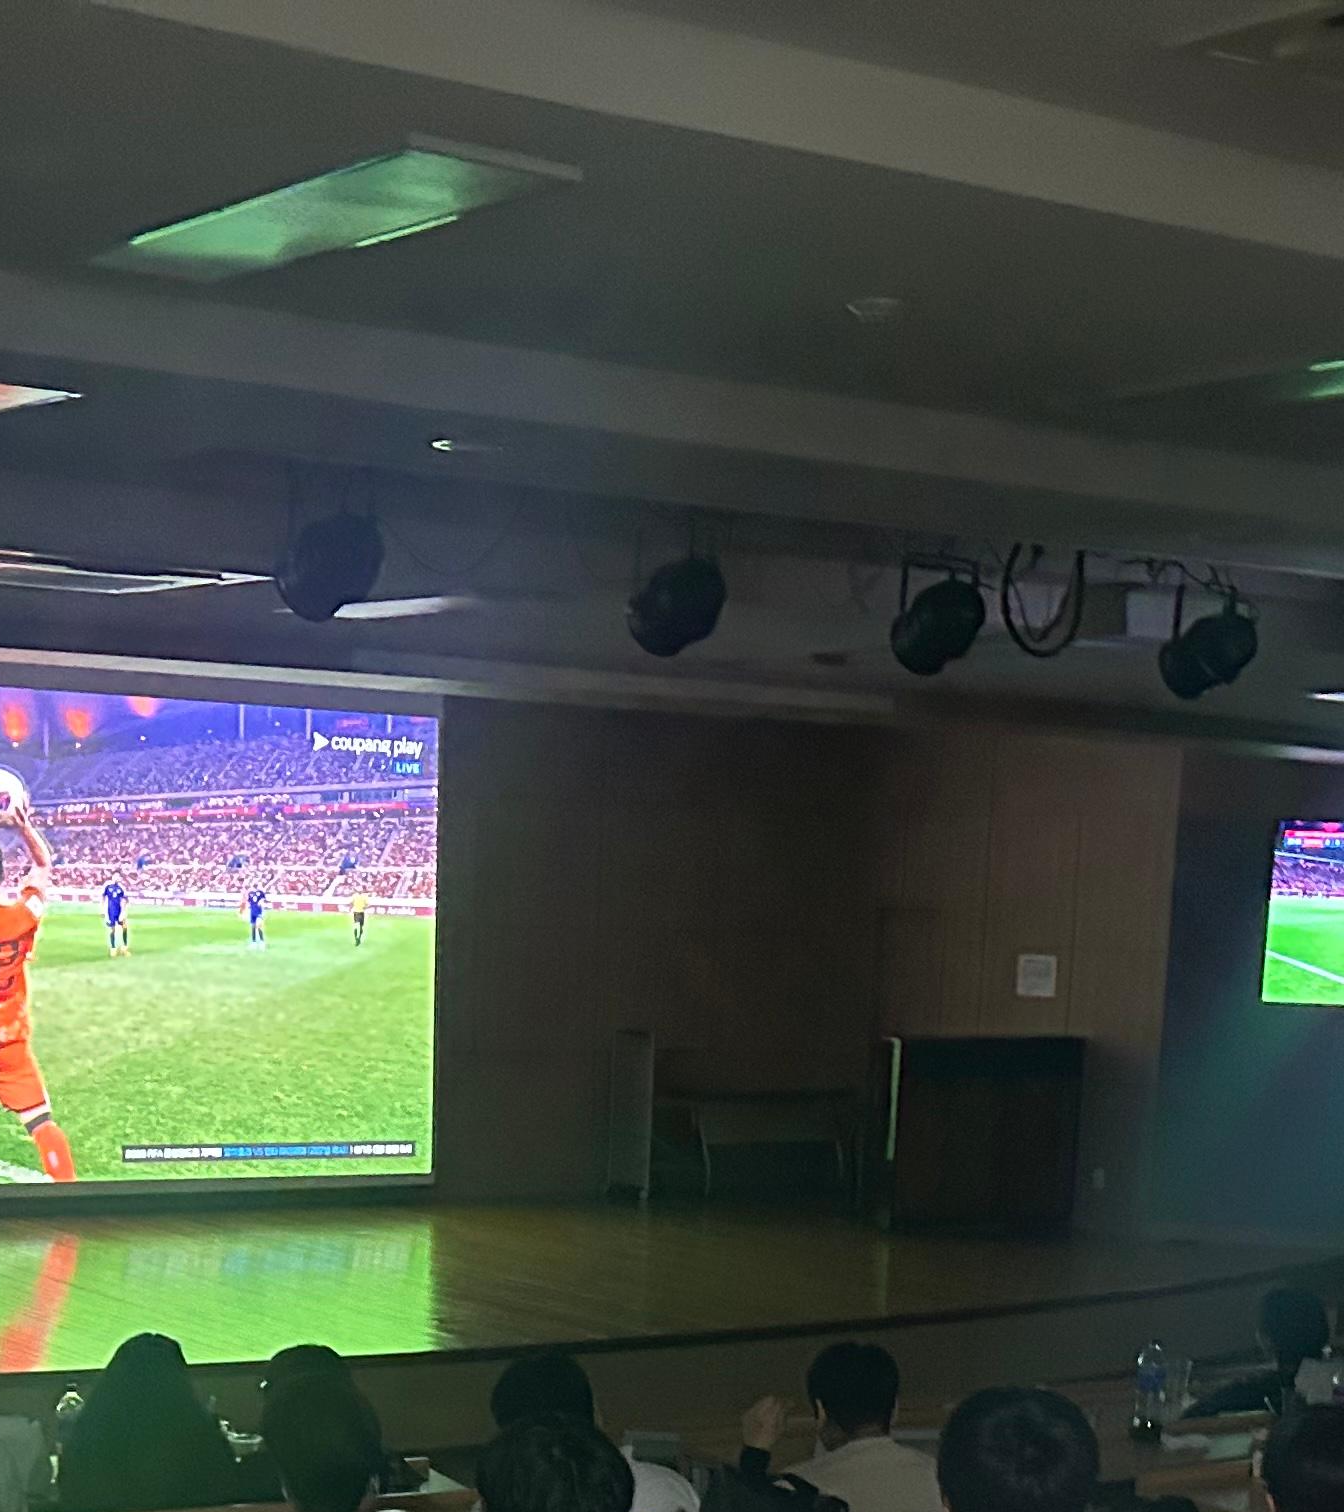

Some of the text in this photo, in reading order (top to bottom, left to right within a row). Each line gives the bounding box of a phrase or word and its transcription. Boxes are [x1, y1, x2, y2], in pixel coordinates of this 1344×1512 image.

[331, 735, 423, 759] coupang play
[395, 763, 420, 775] LIVE
